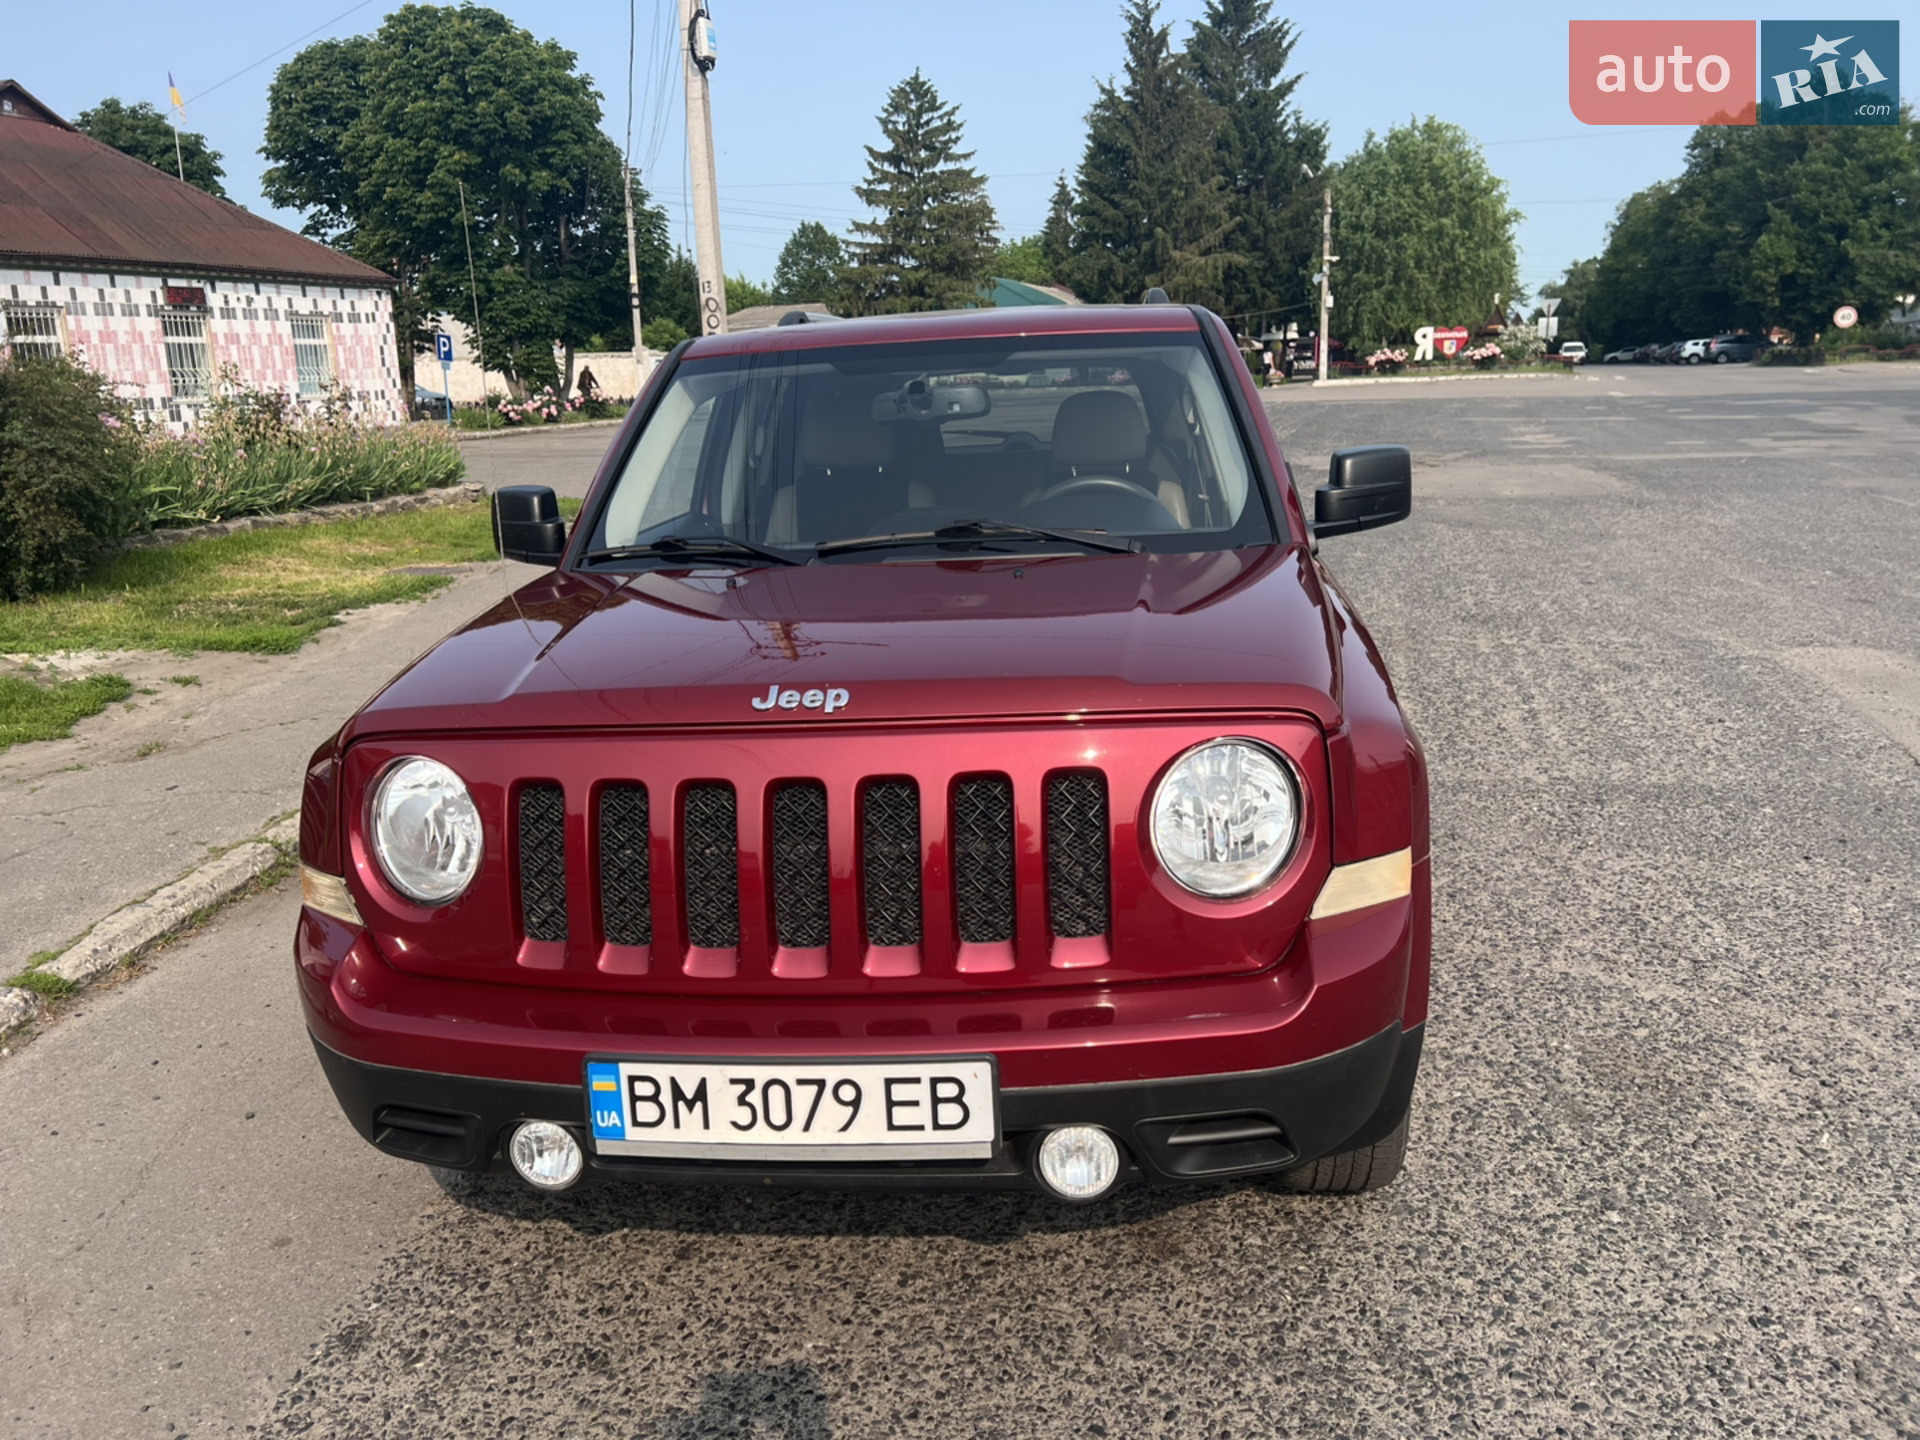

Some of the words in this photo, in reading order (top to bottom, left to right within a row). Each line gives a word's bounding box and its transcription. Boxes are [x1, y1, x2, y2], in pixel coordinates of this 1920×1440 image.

[702, 281, 711, 294] 13
[1840, 312, 1852, 321] 40
[440, 336, 450, 359] P
[1414, 326, 1435, 361] Я
[751, 684, 850, 713] Jeep
[627, 1075, 710, 1130] BM
[729, 1078, 862, 1132] 3079
[884, 1076, 970, 1131] EB
[596, 1110, 622, 1128] UA
